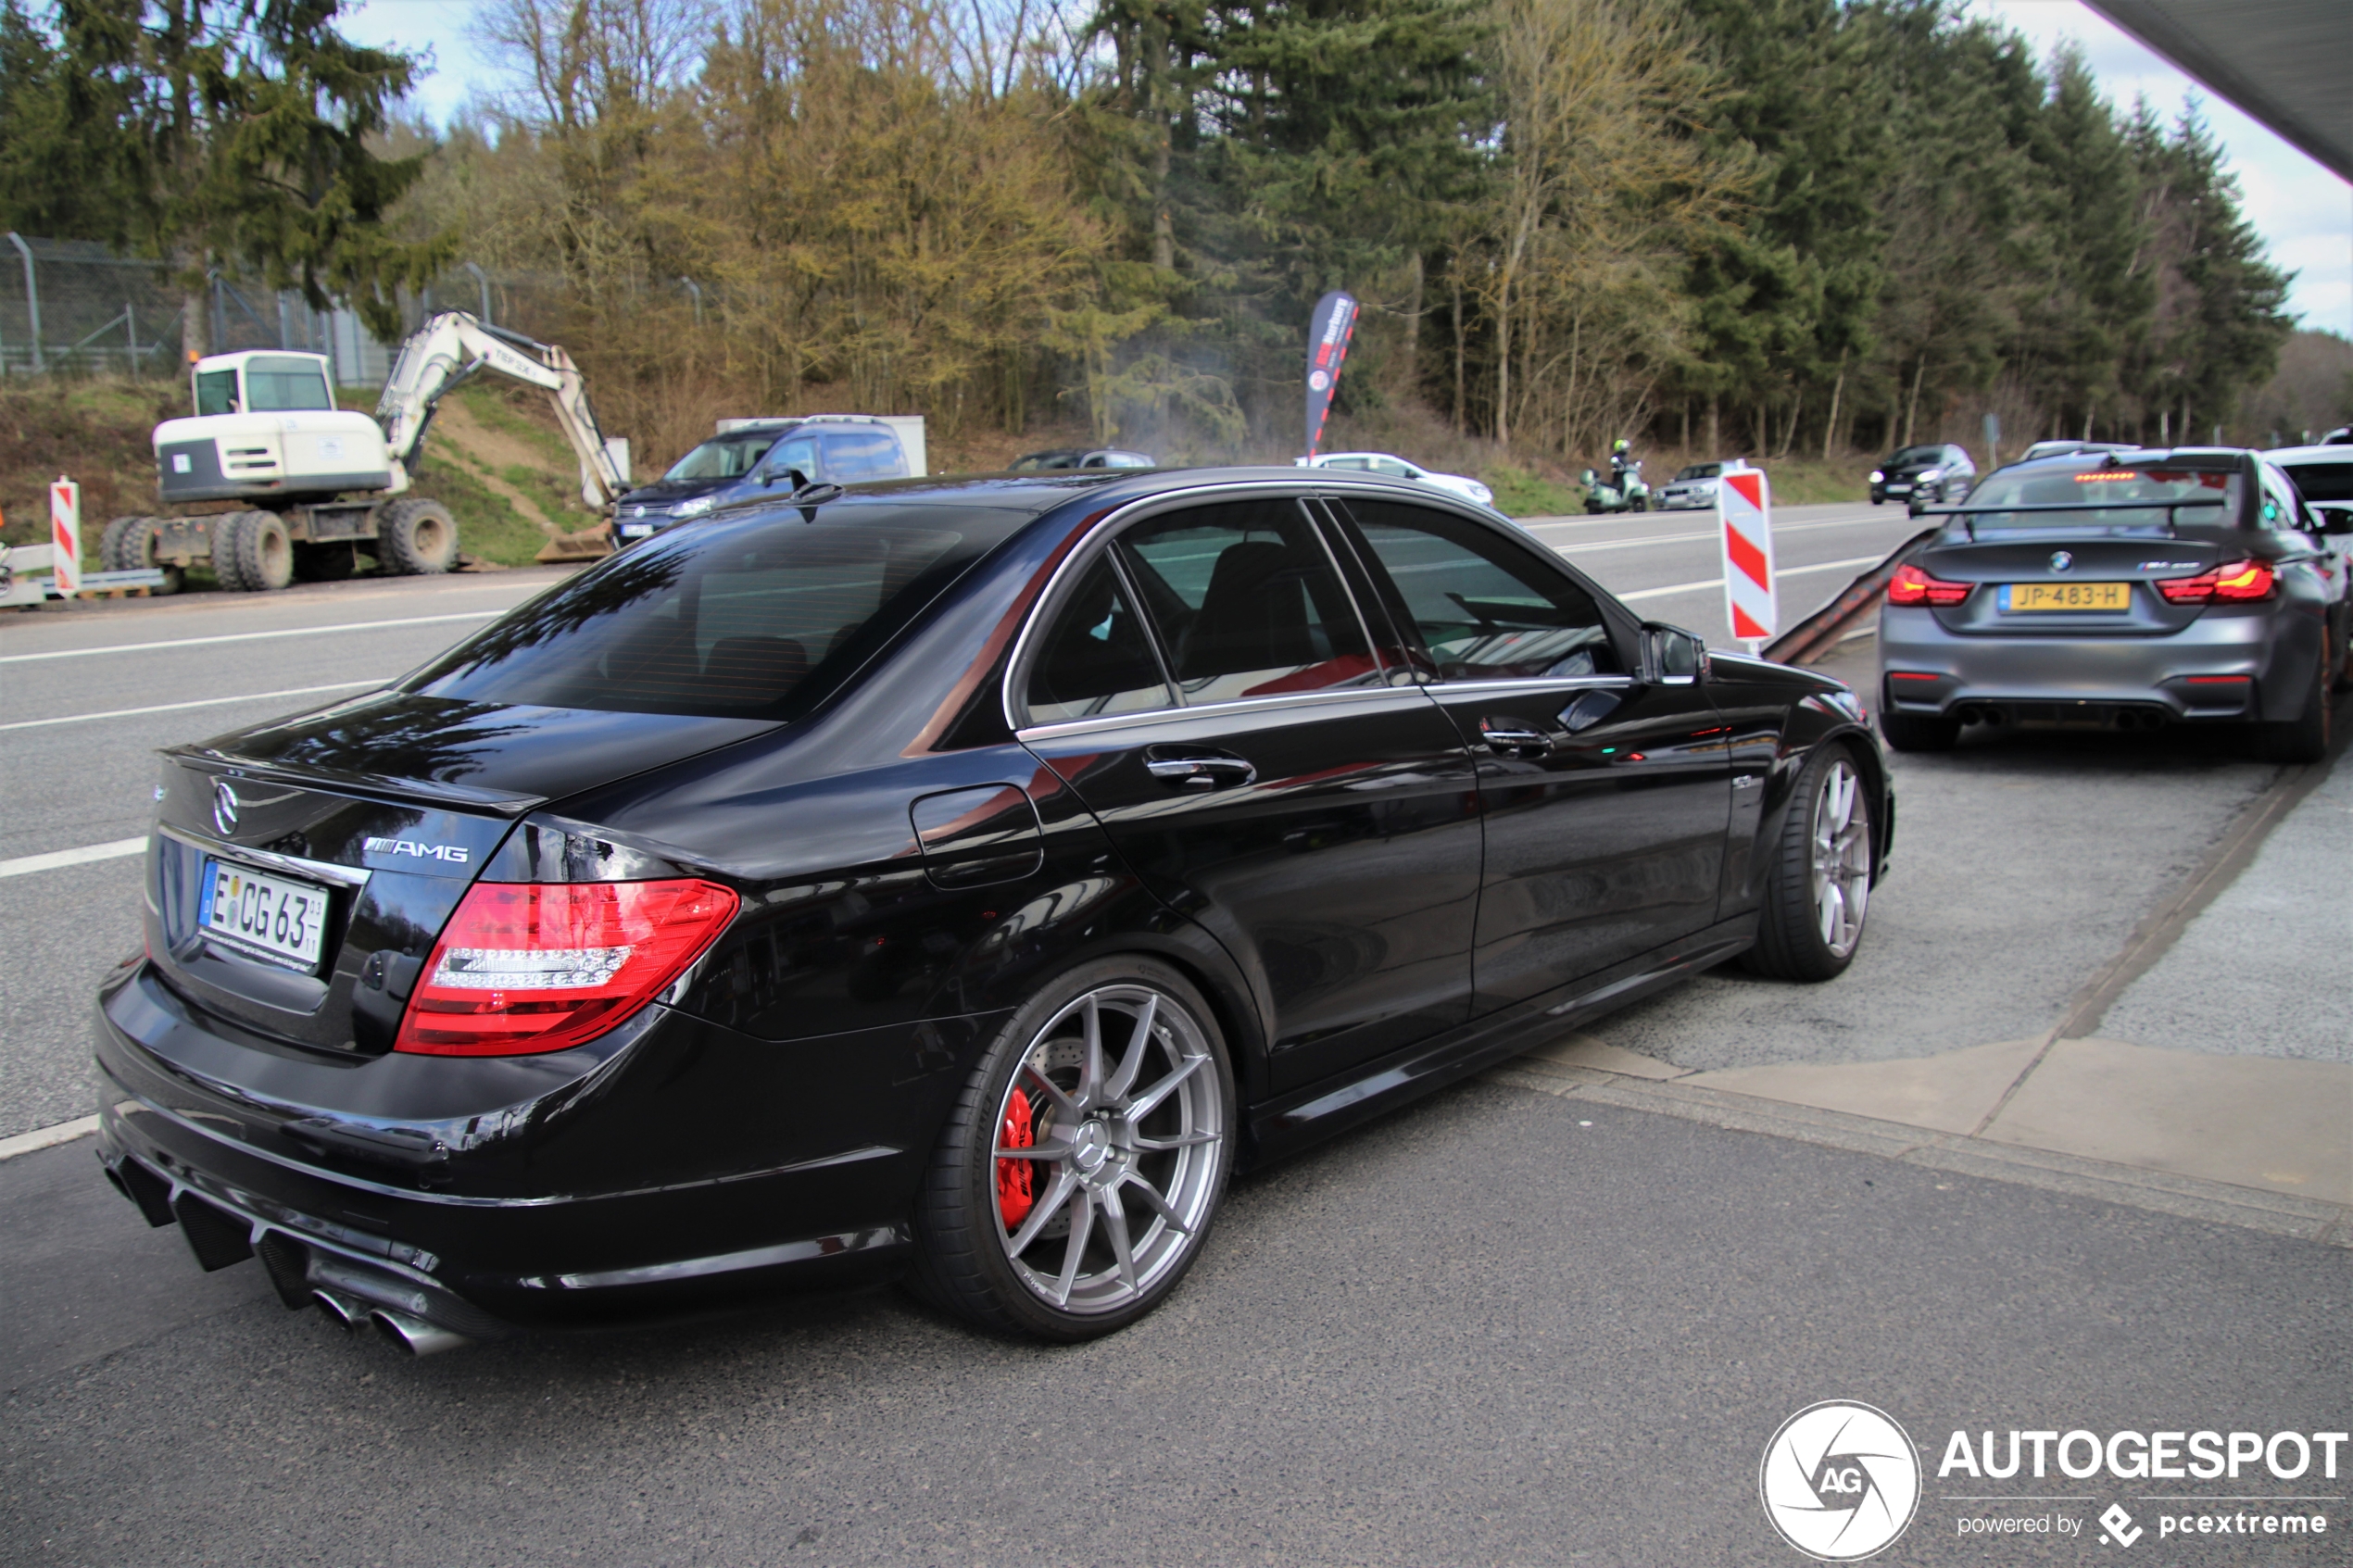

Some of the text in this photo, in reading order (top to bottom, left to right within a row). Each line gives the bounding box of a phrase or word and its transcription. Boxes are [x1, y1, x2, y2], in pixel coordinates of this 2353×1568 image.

[2019, 586, 2118, 606] JP-483-H
[213, 872, 308, 948] E CG 63
